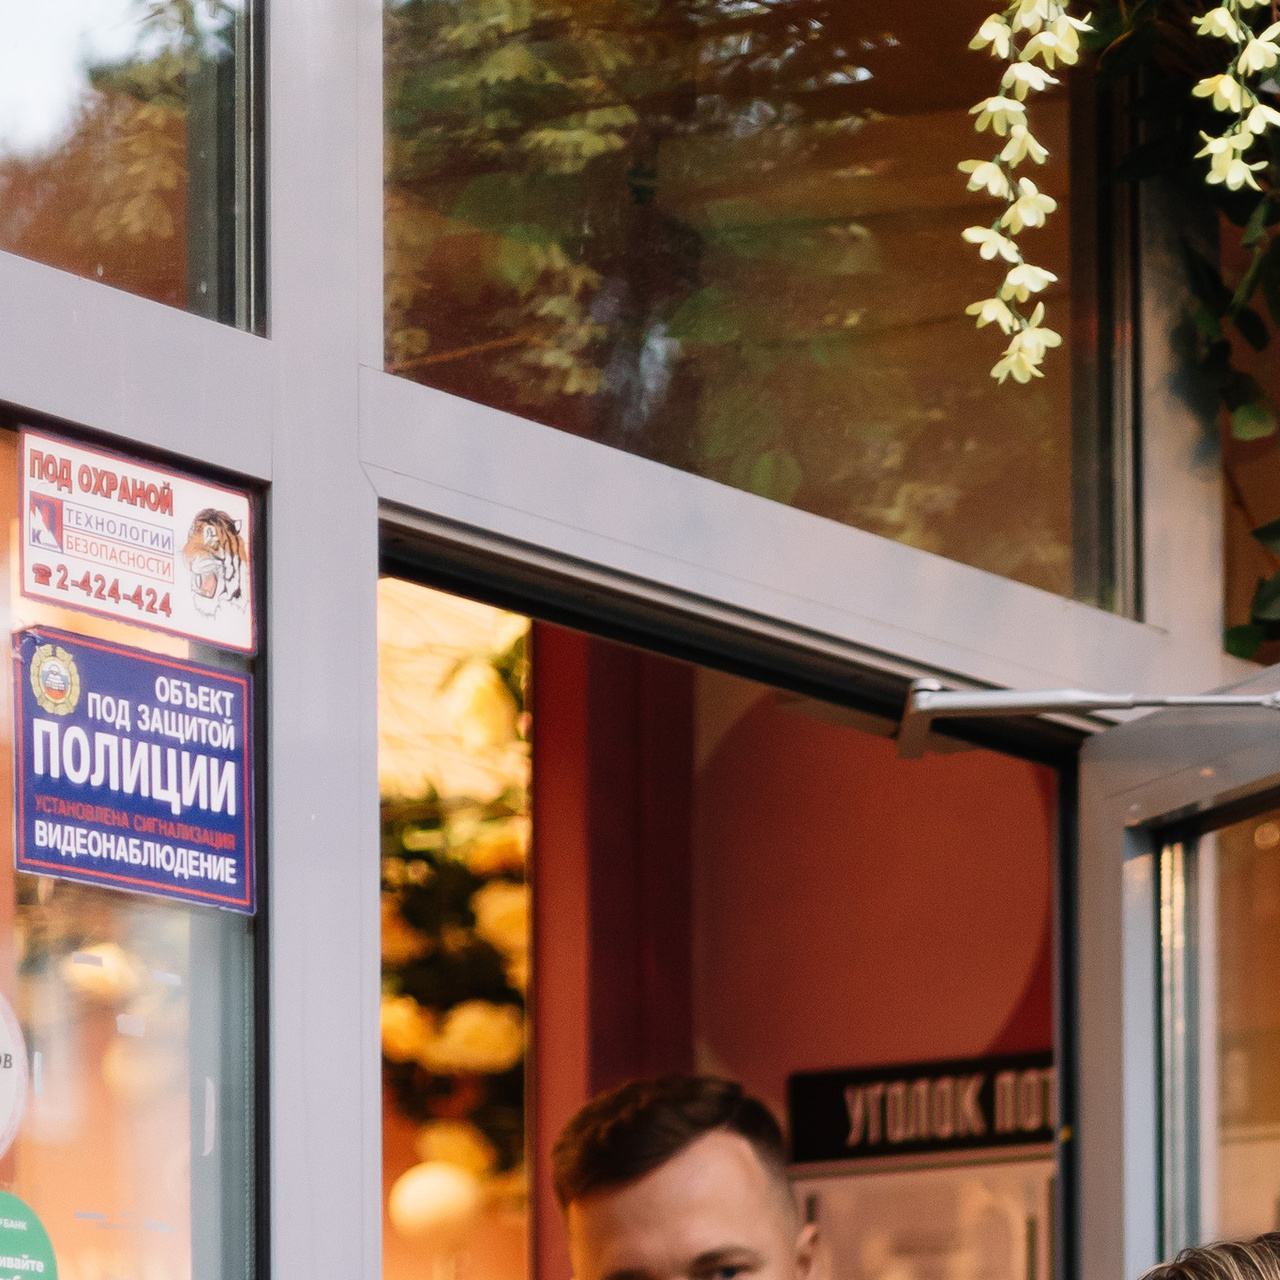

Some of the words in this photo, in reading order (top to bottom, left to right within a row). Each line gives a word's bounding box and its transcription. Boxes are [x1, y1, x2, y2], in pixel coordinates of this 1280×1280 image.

[30, 448, 73, 494] ПОД
[78, 463, 174, 517] ОХРАНОЙ
[66, 507, 171, 551] ТЕХНОЛОГИИ
[66, 534, 171, 577] БЕЗОПАСНОСТИ
[56, 563, 172, 617] 2-424-424
[87, 692, 131, 732] ПОД
[137, 704, 235, 750] ЗАЩИТОЙ
[155, 676, 234, 717] ОБЪЕКТ
[33, 718, 236, 816] ПОЛИЦИИ
[34, 794, 129, 828] УСТАНОВЛЕНА
[133, 814, 236, 850] СИГНАЛИЗАЦИЯ
[34, 820, 237, 884] ВИДЕОНАБЛЮДЕНИЕ
